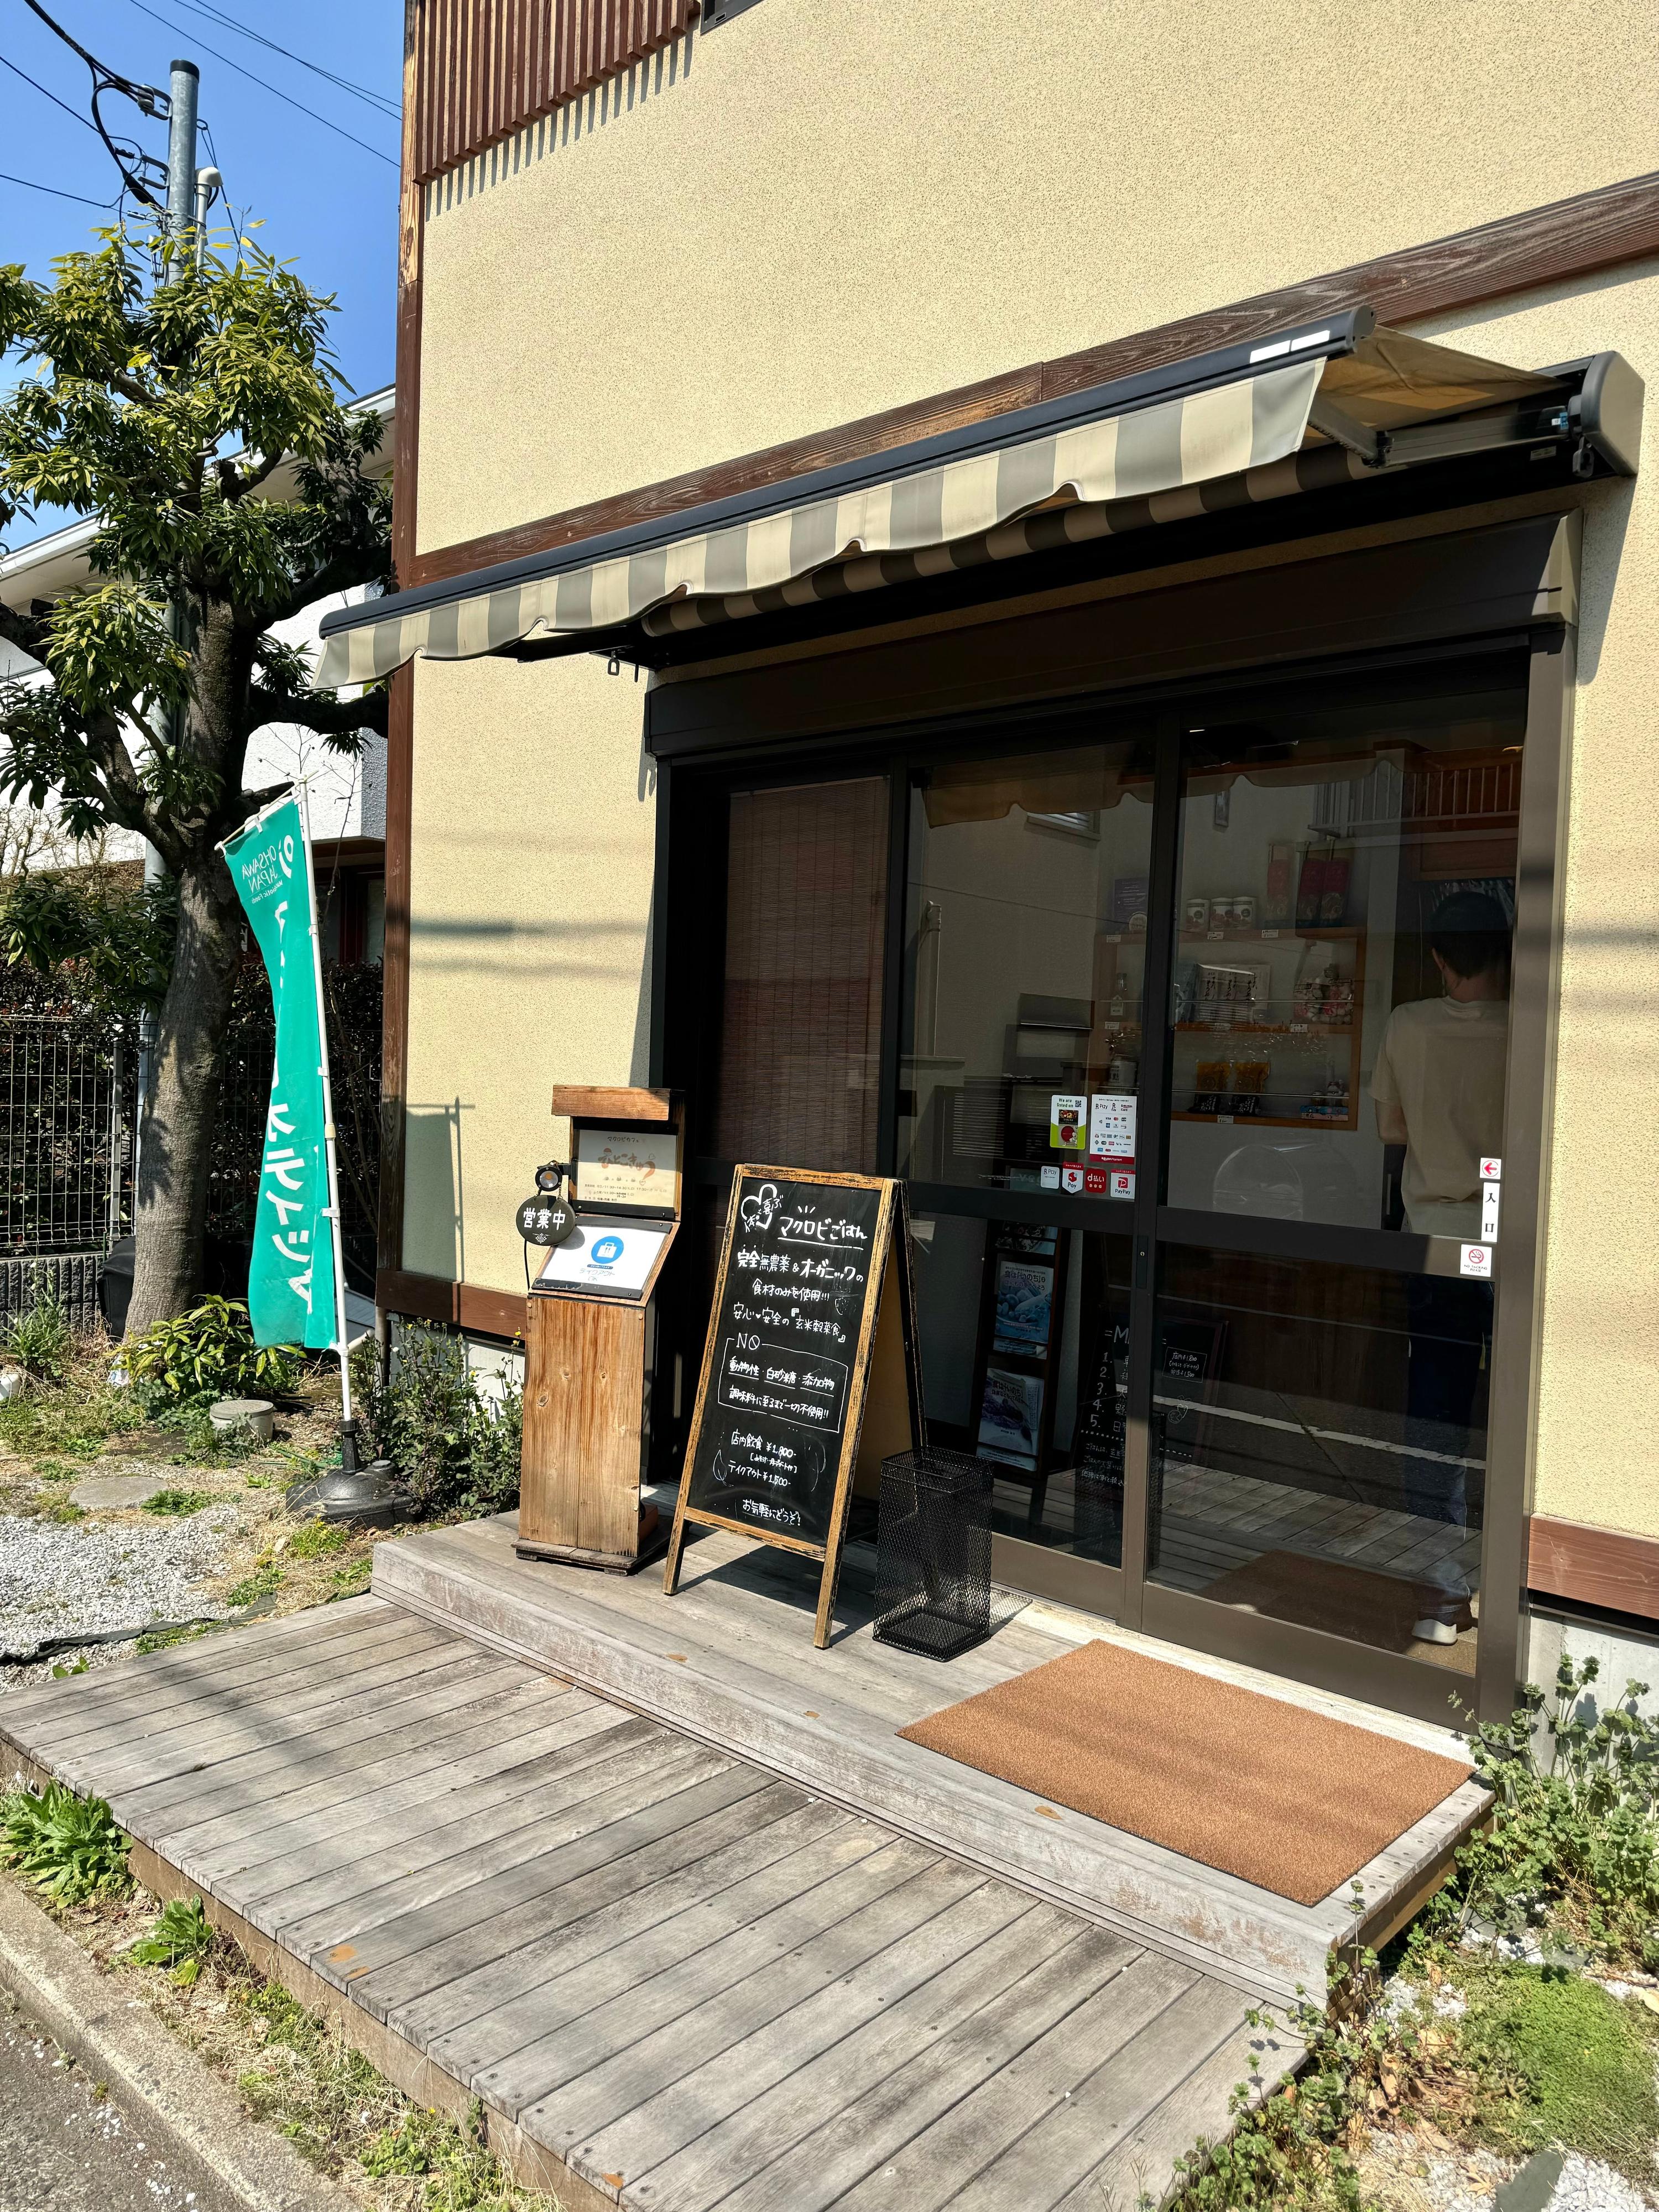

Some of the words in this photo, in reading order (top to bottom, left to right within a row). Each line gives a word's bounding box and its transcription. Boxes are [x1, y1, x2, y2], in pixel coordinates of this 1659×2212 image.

[1087, 1173, 1104, 1182] d払い
[523, 1207, 566, 1230] 営業中
[1485, 1193, 1496, 1233] 入口
[779, 1216, 868, 1240] マクロビごはん
[579, 1268, 615, 1276] テイクアウト
[736, 1332, 760, 1350] NO
[731, 1428, 763, 1451] 店内飲食
[742, 1499, 801, 1526] お気軽にどうぞ!
